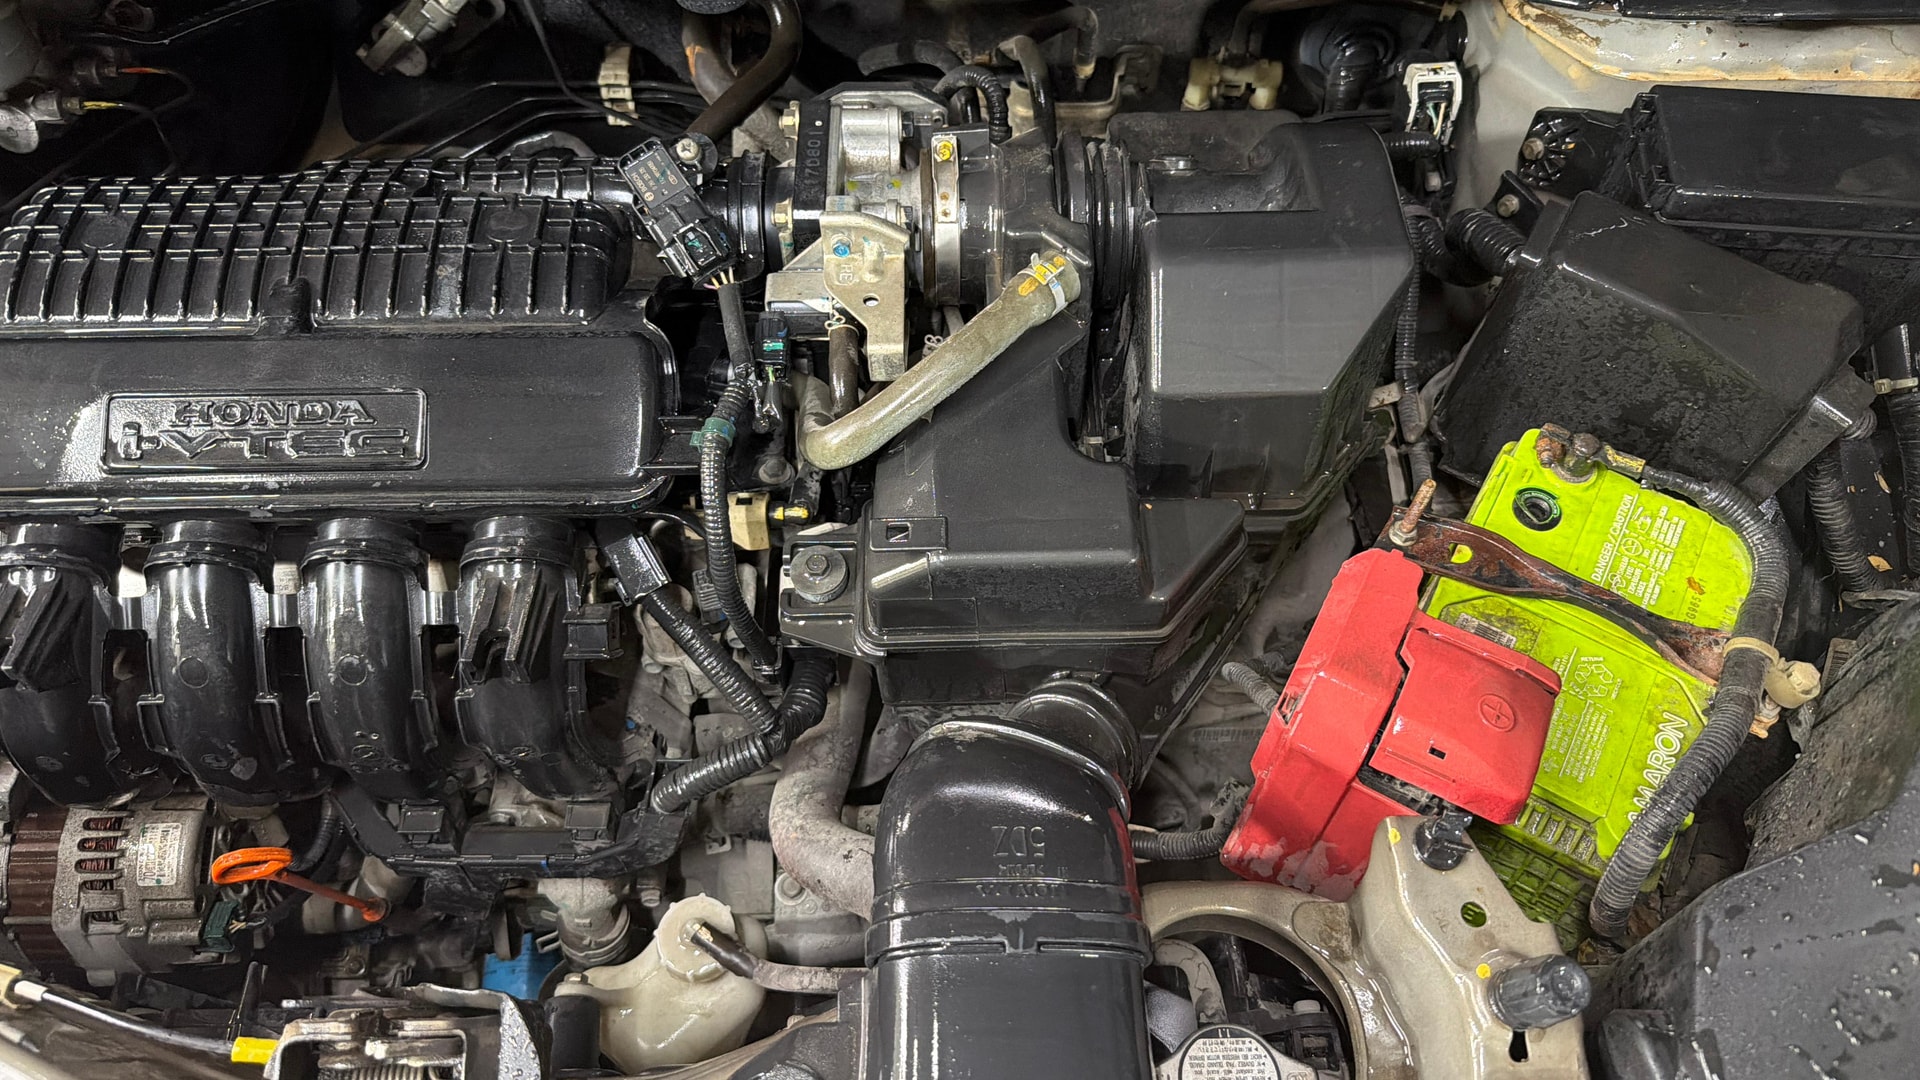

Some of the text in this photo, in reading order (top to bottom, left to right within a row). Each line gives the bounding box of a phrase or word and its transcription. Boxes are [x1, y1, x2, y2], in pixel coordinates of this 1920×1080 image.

[631, 172, 648, 192] BOSCH
[170, 400, 377, 427] HONDA
[1590, 541, 1615, 581] DANGER
[1609, 493, 1634, 536] CAUTION
[1218, 1028, 1230, 1037] 1.1
